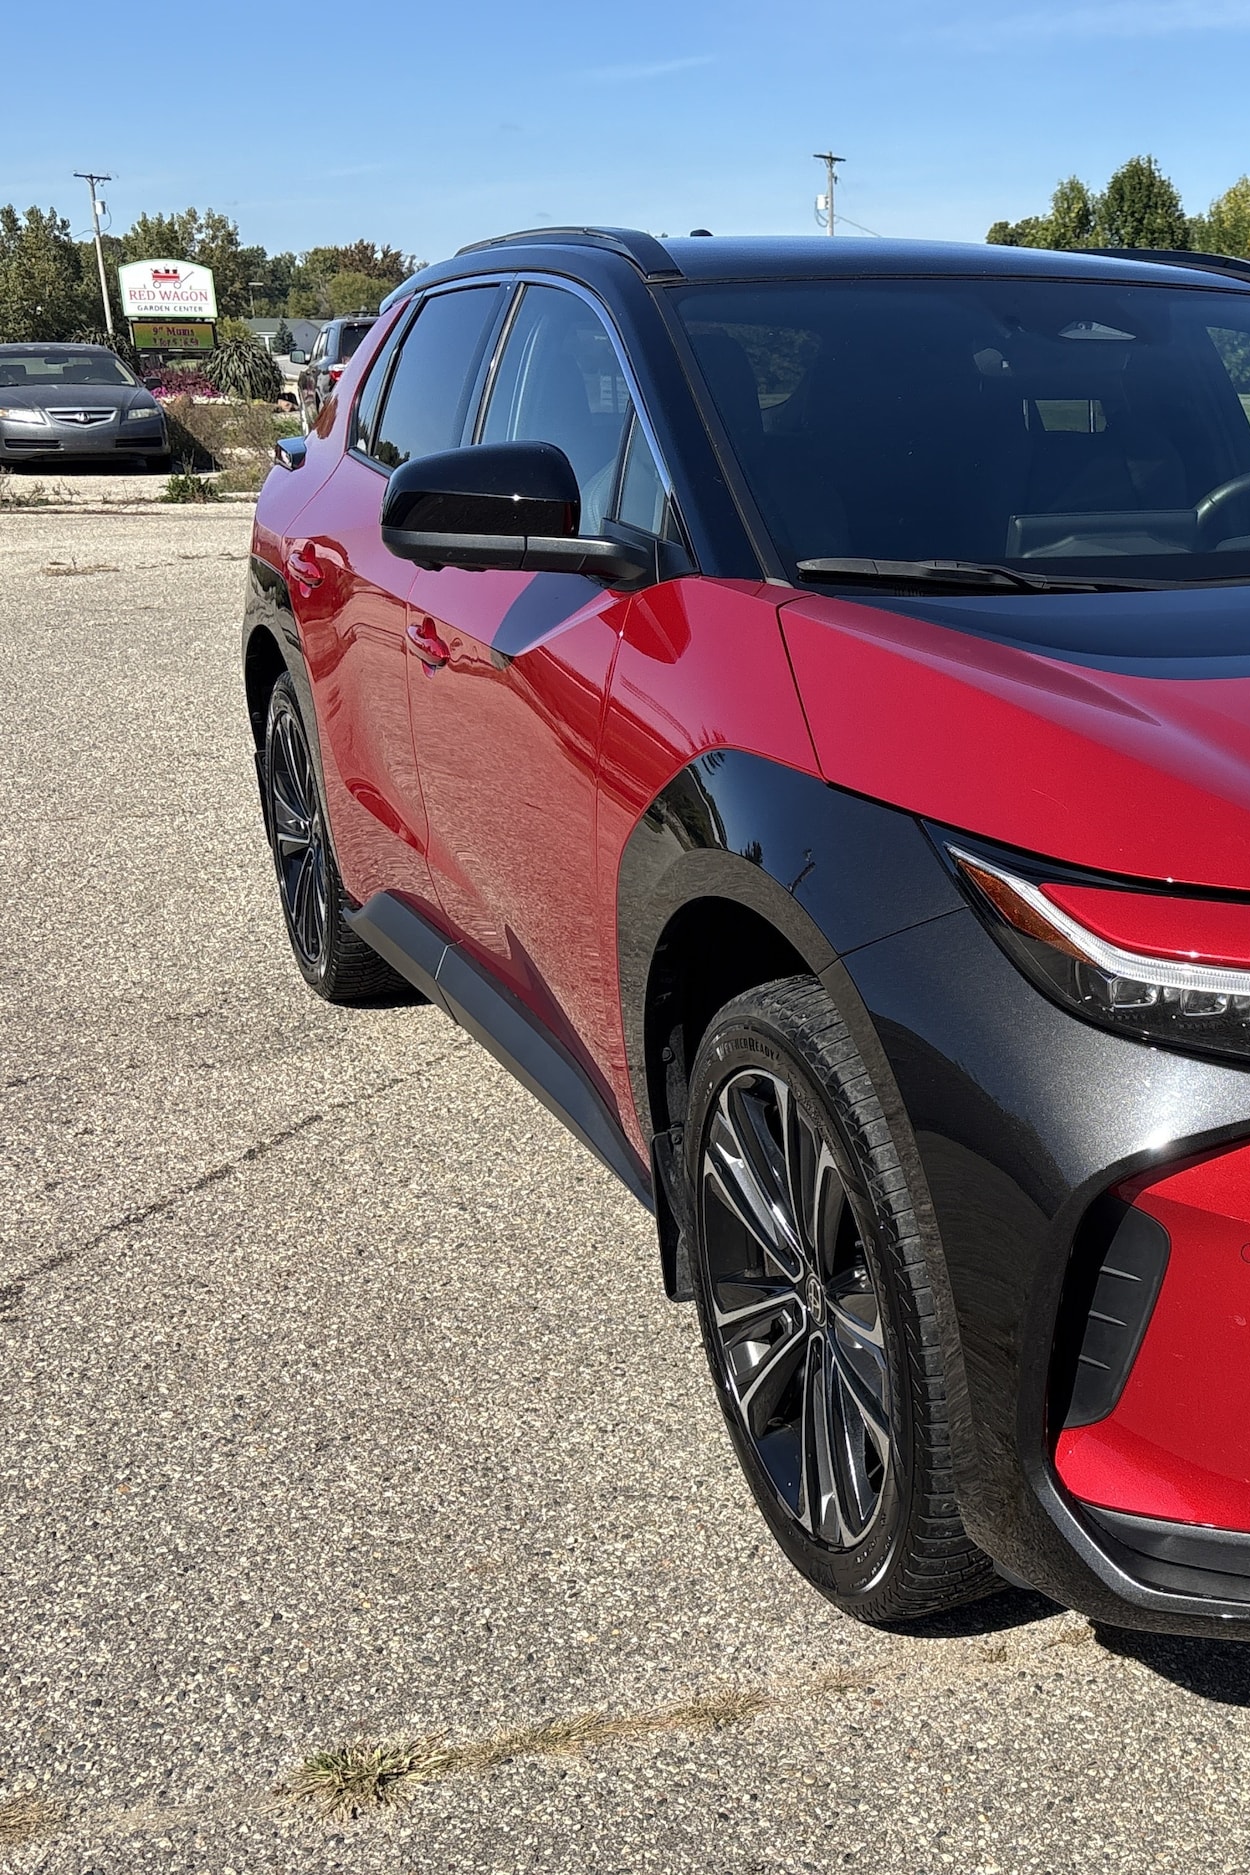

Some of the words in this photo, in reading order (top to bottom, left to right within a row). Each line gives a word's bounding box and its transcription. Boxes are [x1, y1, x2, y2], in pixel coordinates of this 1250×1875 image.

[129, 290, 156, 301] RED
[159, 290, 208, 302] WAGON
[166, 327, 195, 336] Mums
